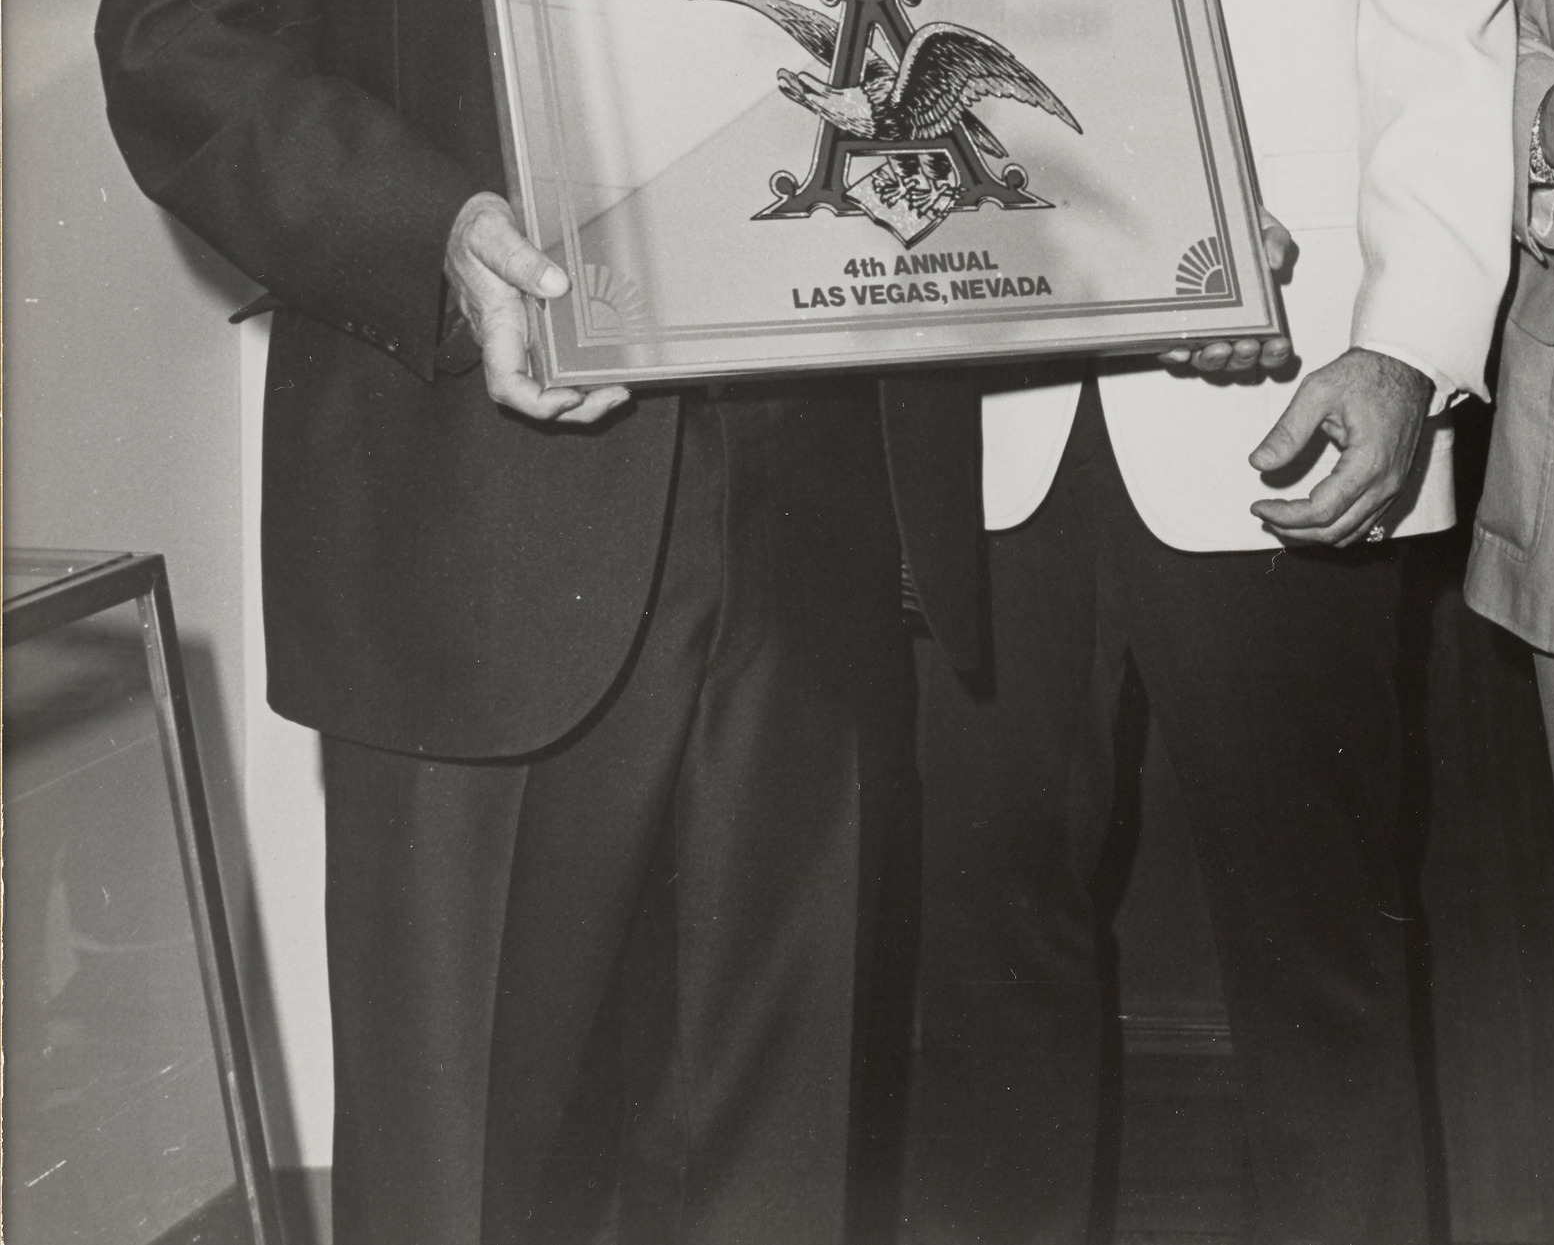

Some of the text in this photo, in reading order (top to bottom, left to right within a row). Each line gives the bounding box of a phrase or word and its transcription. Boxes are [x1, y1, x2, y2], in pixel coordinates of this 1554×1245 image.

[842, 249, 999, 279] 4th ANNUAL
[792, 276, 1053, 310] LAS VEGAS, NEVADA
